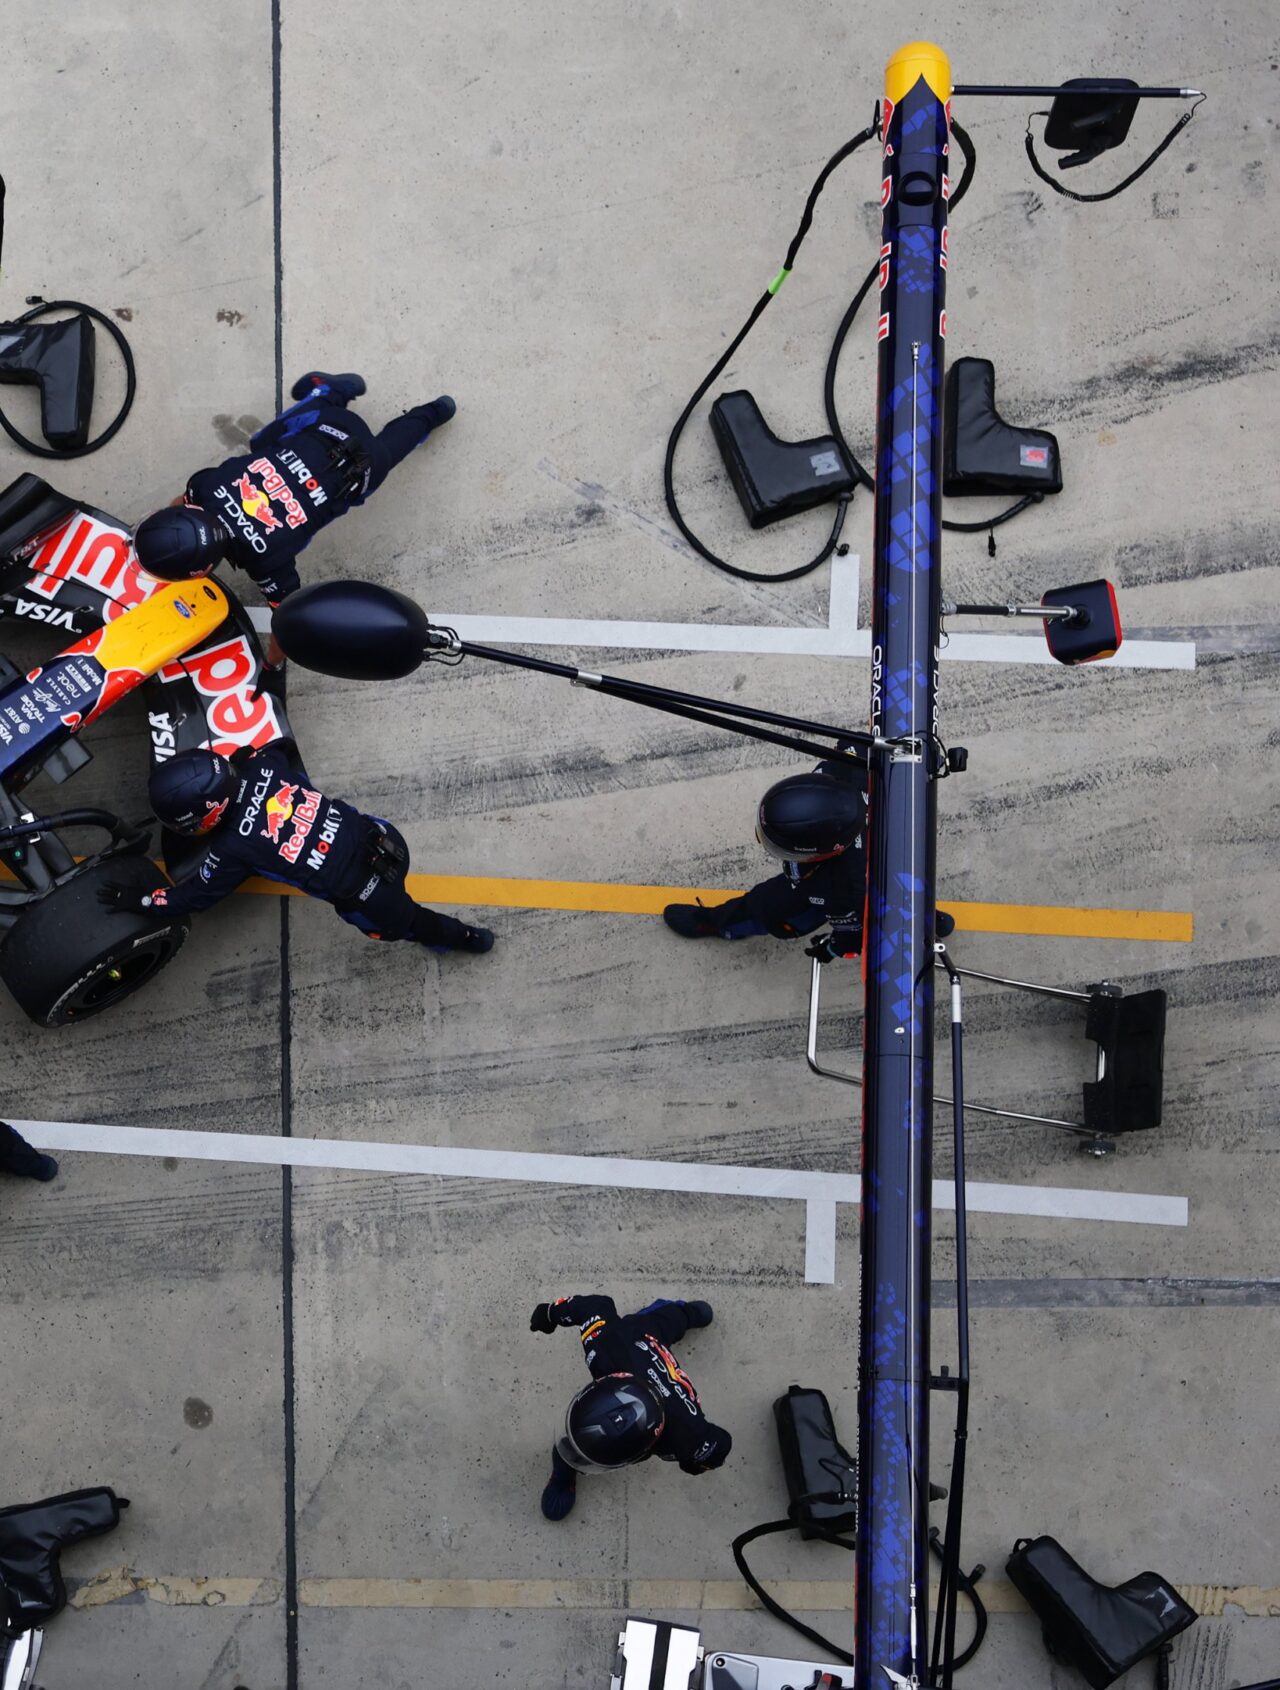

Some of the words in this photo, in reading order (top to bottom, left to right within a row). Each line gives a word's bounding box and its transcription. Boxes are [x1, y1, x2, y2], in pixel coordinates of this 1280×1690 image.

[247, 457, 286, 494] Bull
[287, 459, 328, 507] Mobil
[214, 486, 267, 554] ORACLE
[270, 486, 308, 530] Red
[15, 598, 76, 632] VISA
[57, 672, 81, 698] neat.
[872, 645, 882, 738] ORACLE
[4, 707, 23, 723] AT&T
[239, 768, 273, 836] ORACLE
[279, 815, 309, 864] Red
[306, 818, 340, 871] Mobil
